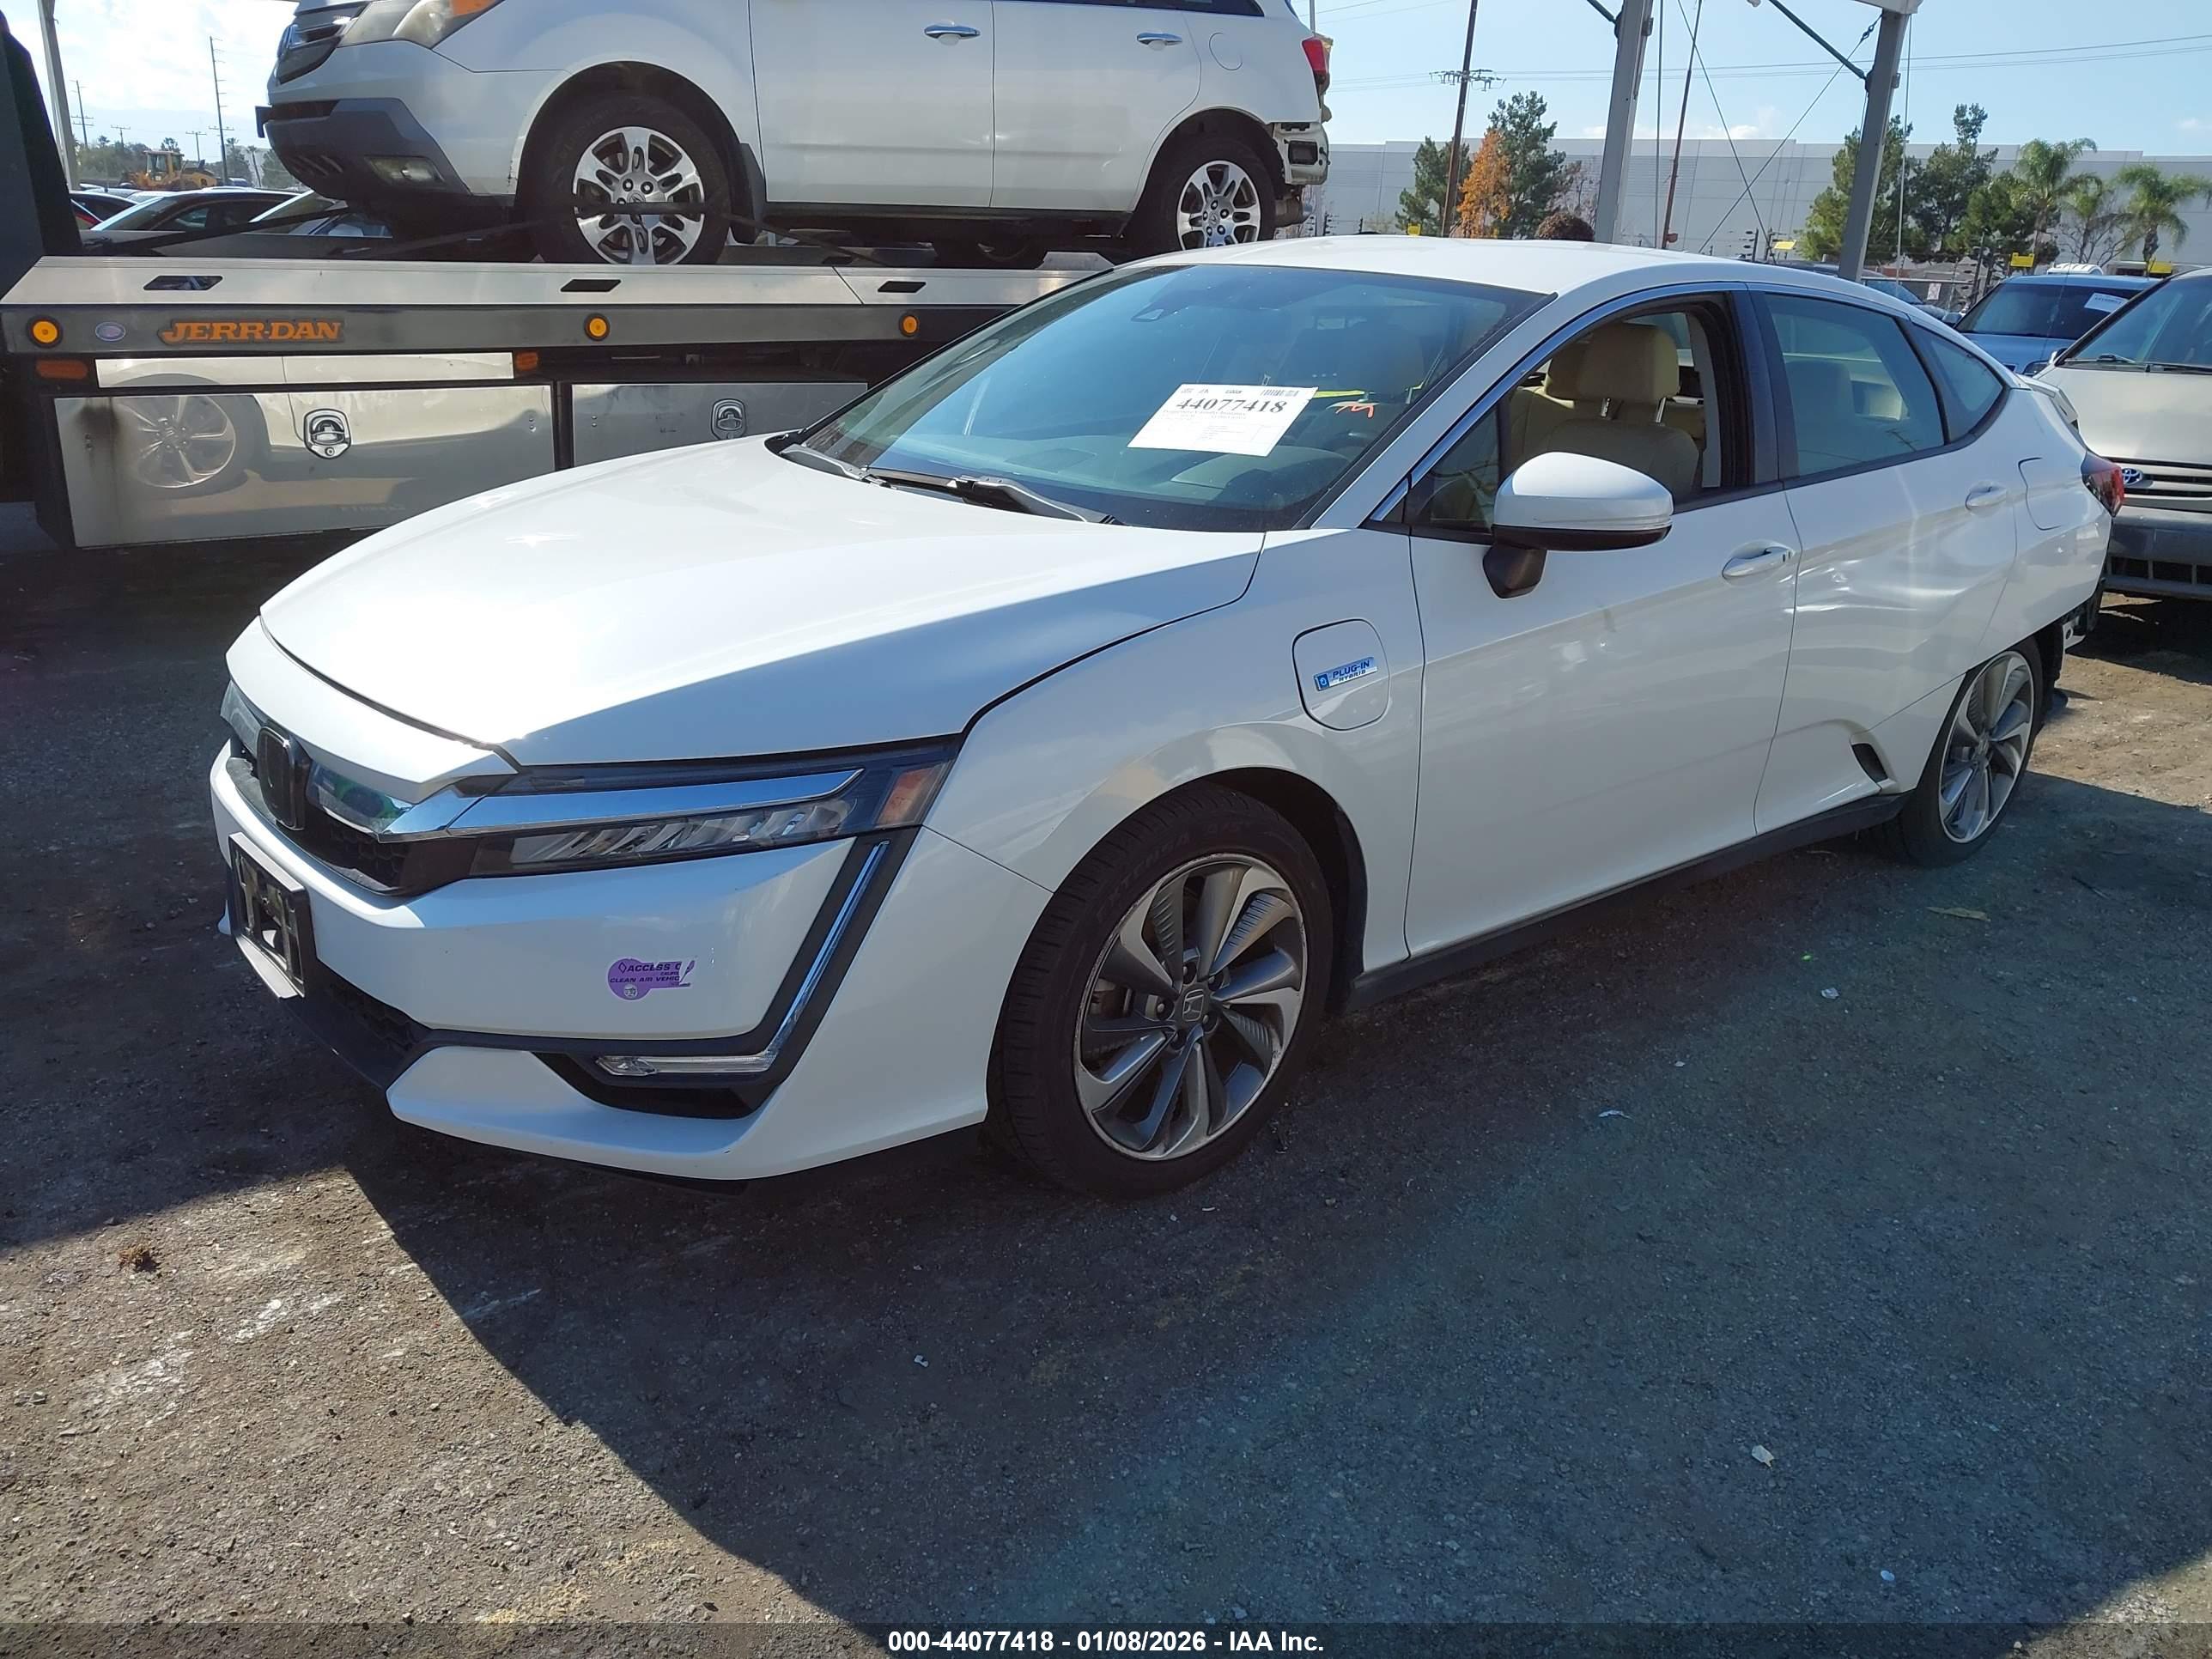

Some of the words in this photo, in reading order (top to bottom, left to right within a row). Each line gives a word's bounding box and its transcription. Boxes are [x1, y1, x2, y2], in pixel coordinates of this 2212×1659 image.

[161, 322, 341, 343] JERR-DAN
[1176, 398, 1288, 414] 44077418
[1333, 659, 1370, 678] PLUG-IN
[1339, 670, 1366, 682] HYBRID
